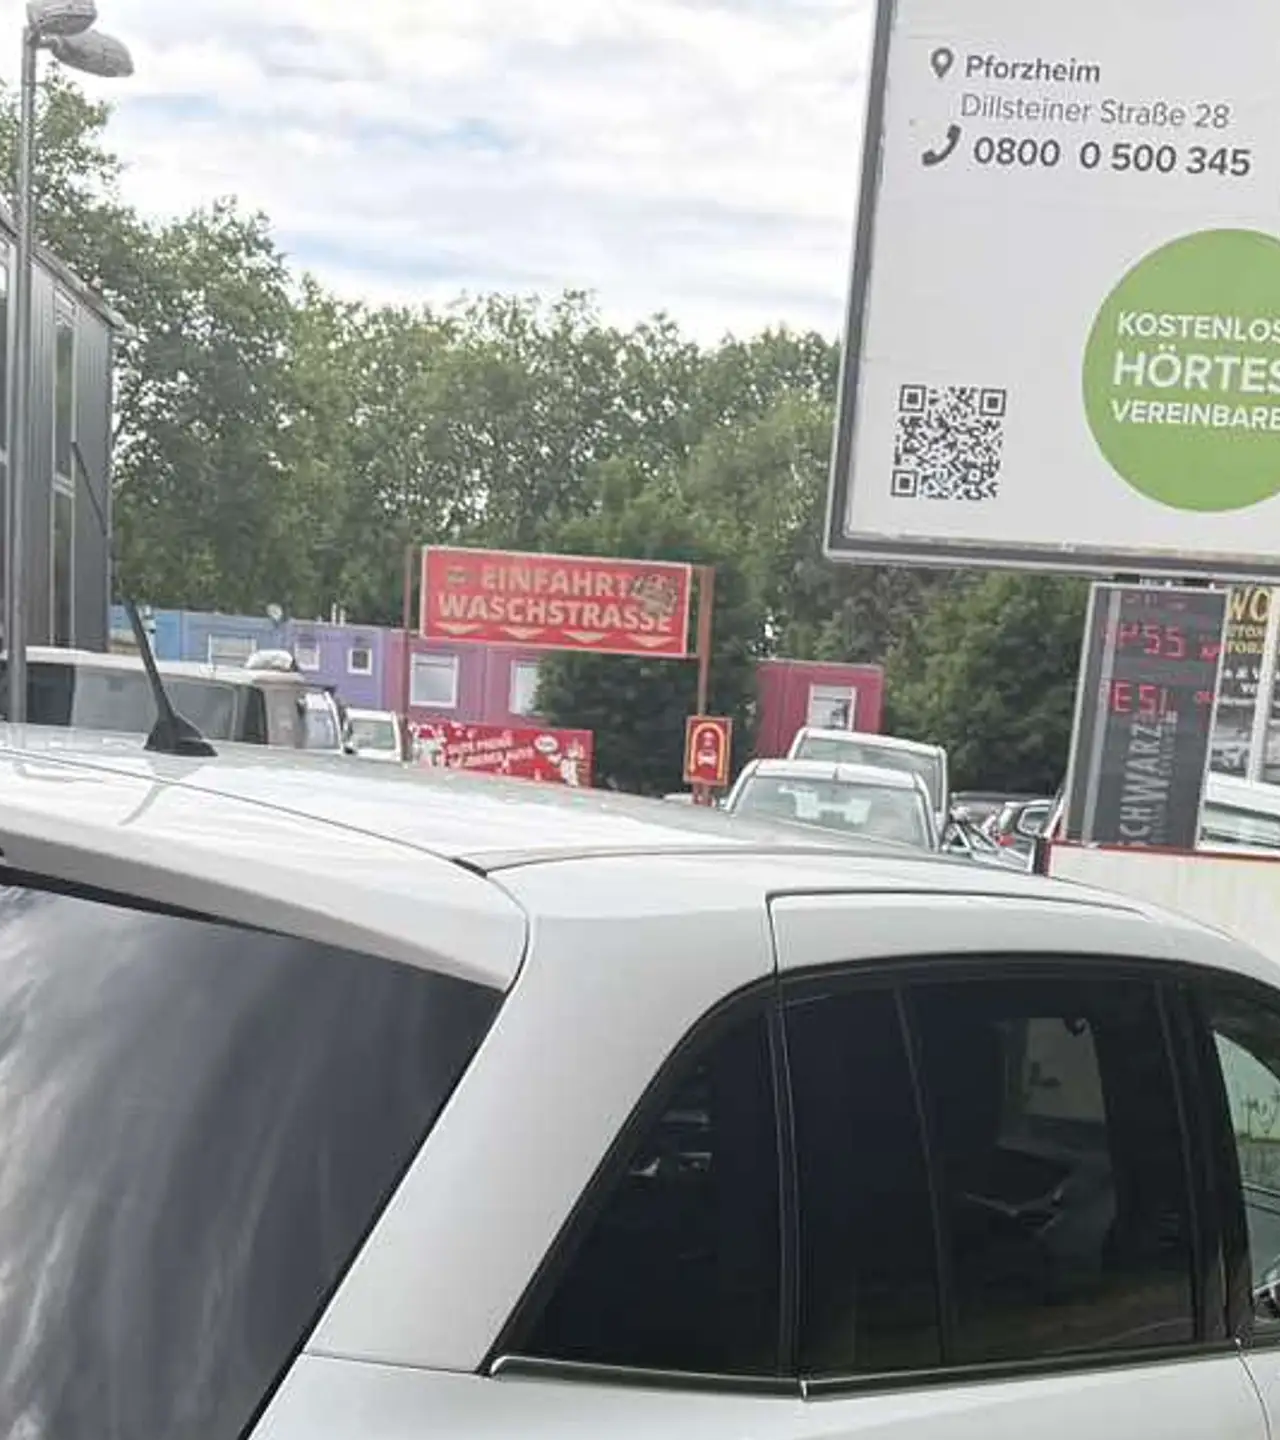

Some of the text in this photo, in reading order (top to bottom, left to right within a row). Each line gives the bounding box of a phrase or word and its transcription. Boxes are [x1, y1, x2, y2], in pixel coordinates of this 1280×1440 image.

[965, 54, 1101, 83] Pforzheim
[961, 92, 1231, 130] Dillsteiner Straße 28
[973, 136, 1252, 177] 0800 0 500 345
[480, 566, 633, 600] EINFAHRT
[438, 594, 673, 632] WASCHSTRASSE
[1119, 722, 1170, 848] CHWARZ
